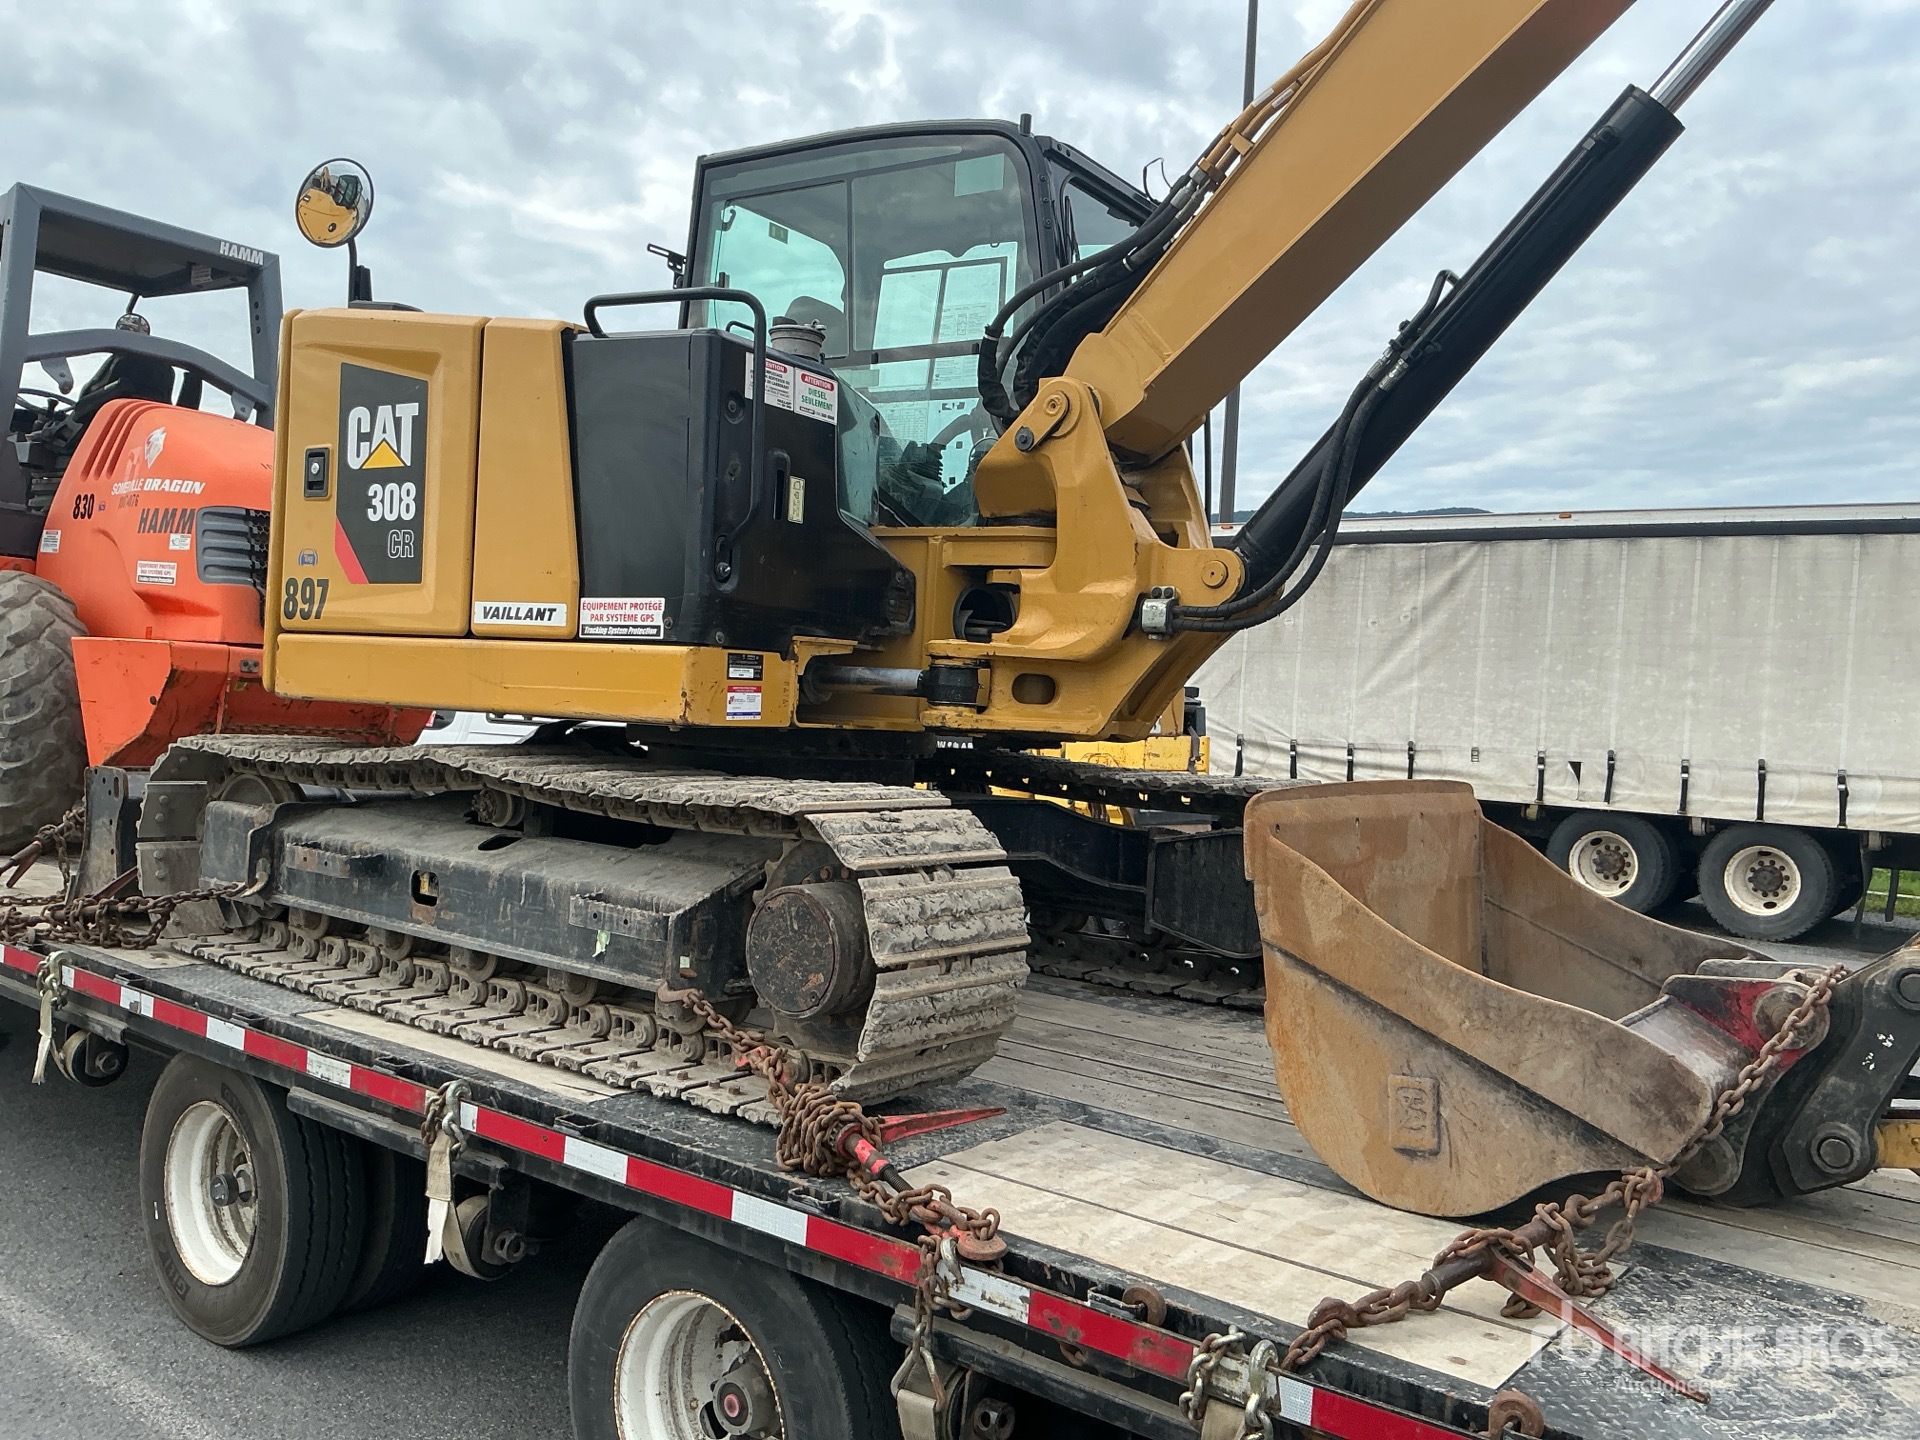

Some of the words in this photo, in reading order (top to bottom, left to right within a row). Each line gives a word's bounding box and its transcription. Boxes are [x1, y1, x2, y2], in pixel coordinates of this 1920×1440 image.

[220, 241, 264, 266] HAMM
[804, 376, 832, 390] ATTENTION
[801, 394, 834, 411] SEULEMENT
[808, 388, 828, 400] DIESEL
[347, 402, 419, 470] CAT
[143, 478, 206, 495] DRAGON
[73, 493, 95, 520] 830
[367, 482, 417, 522] 308
[137, 508, 196, 534] HAMM
[387, 529, 415, 559] CR
[283, 577, 330, 621] 897
[582, 600, 627, 612] ÉQUIPEMENT
[629, 600, 662, 611] PROTÉGÉ
[483, 605, 557, 622] VAILLANT
[590, 613, 604, 622] PAR
[606, 611, 638, 622] SYSTÈME
[640, 613, 655, 623] GPS
[584, 626, 607, 635] Tracking
[628, 627, 657, 635] Protection
